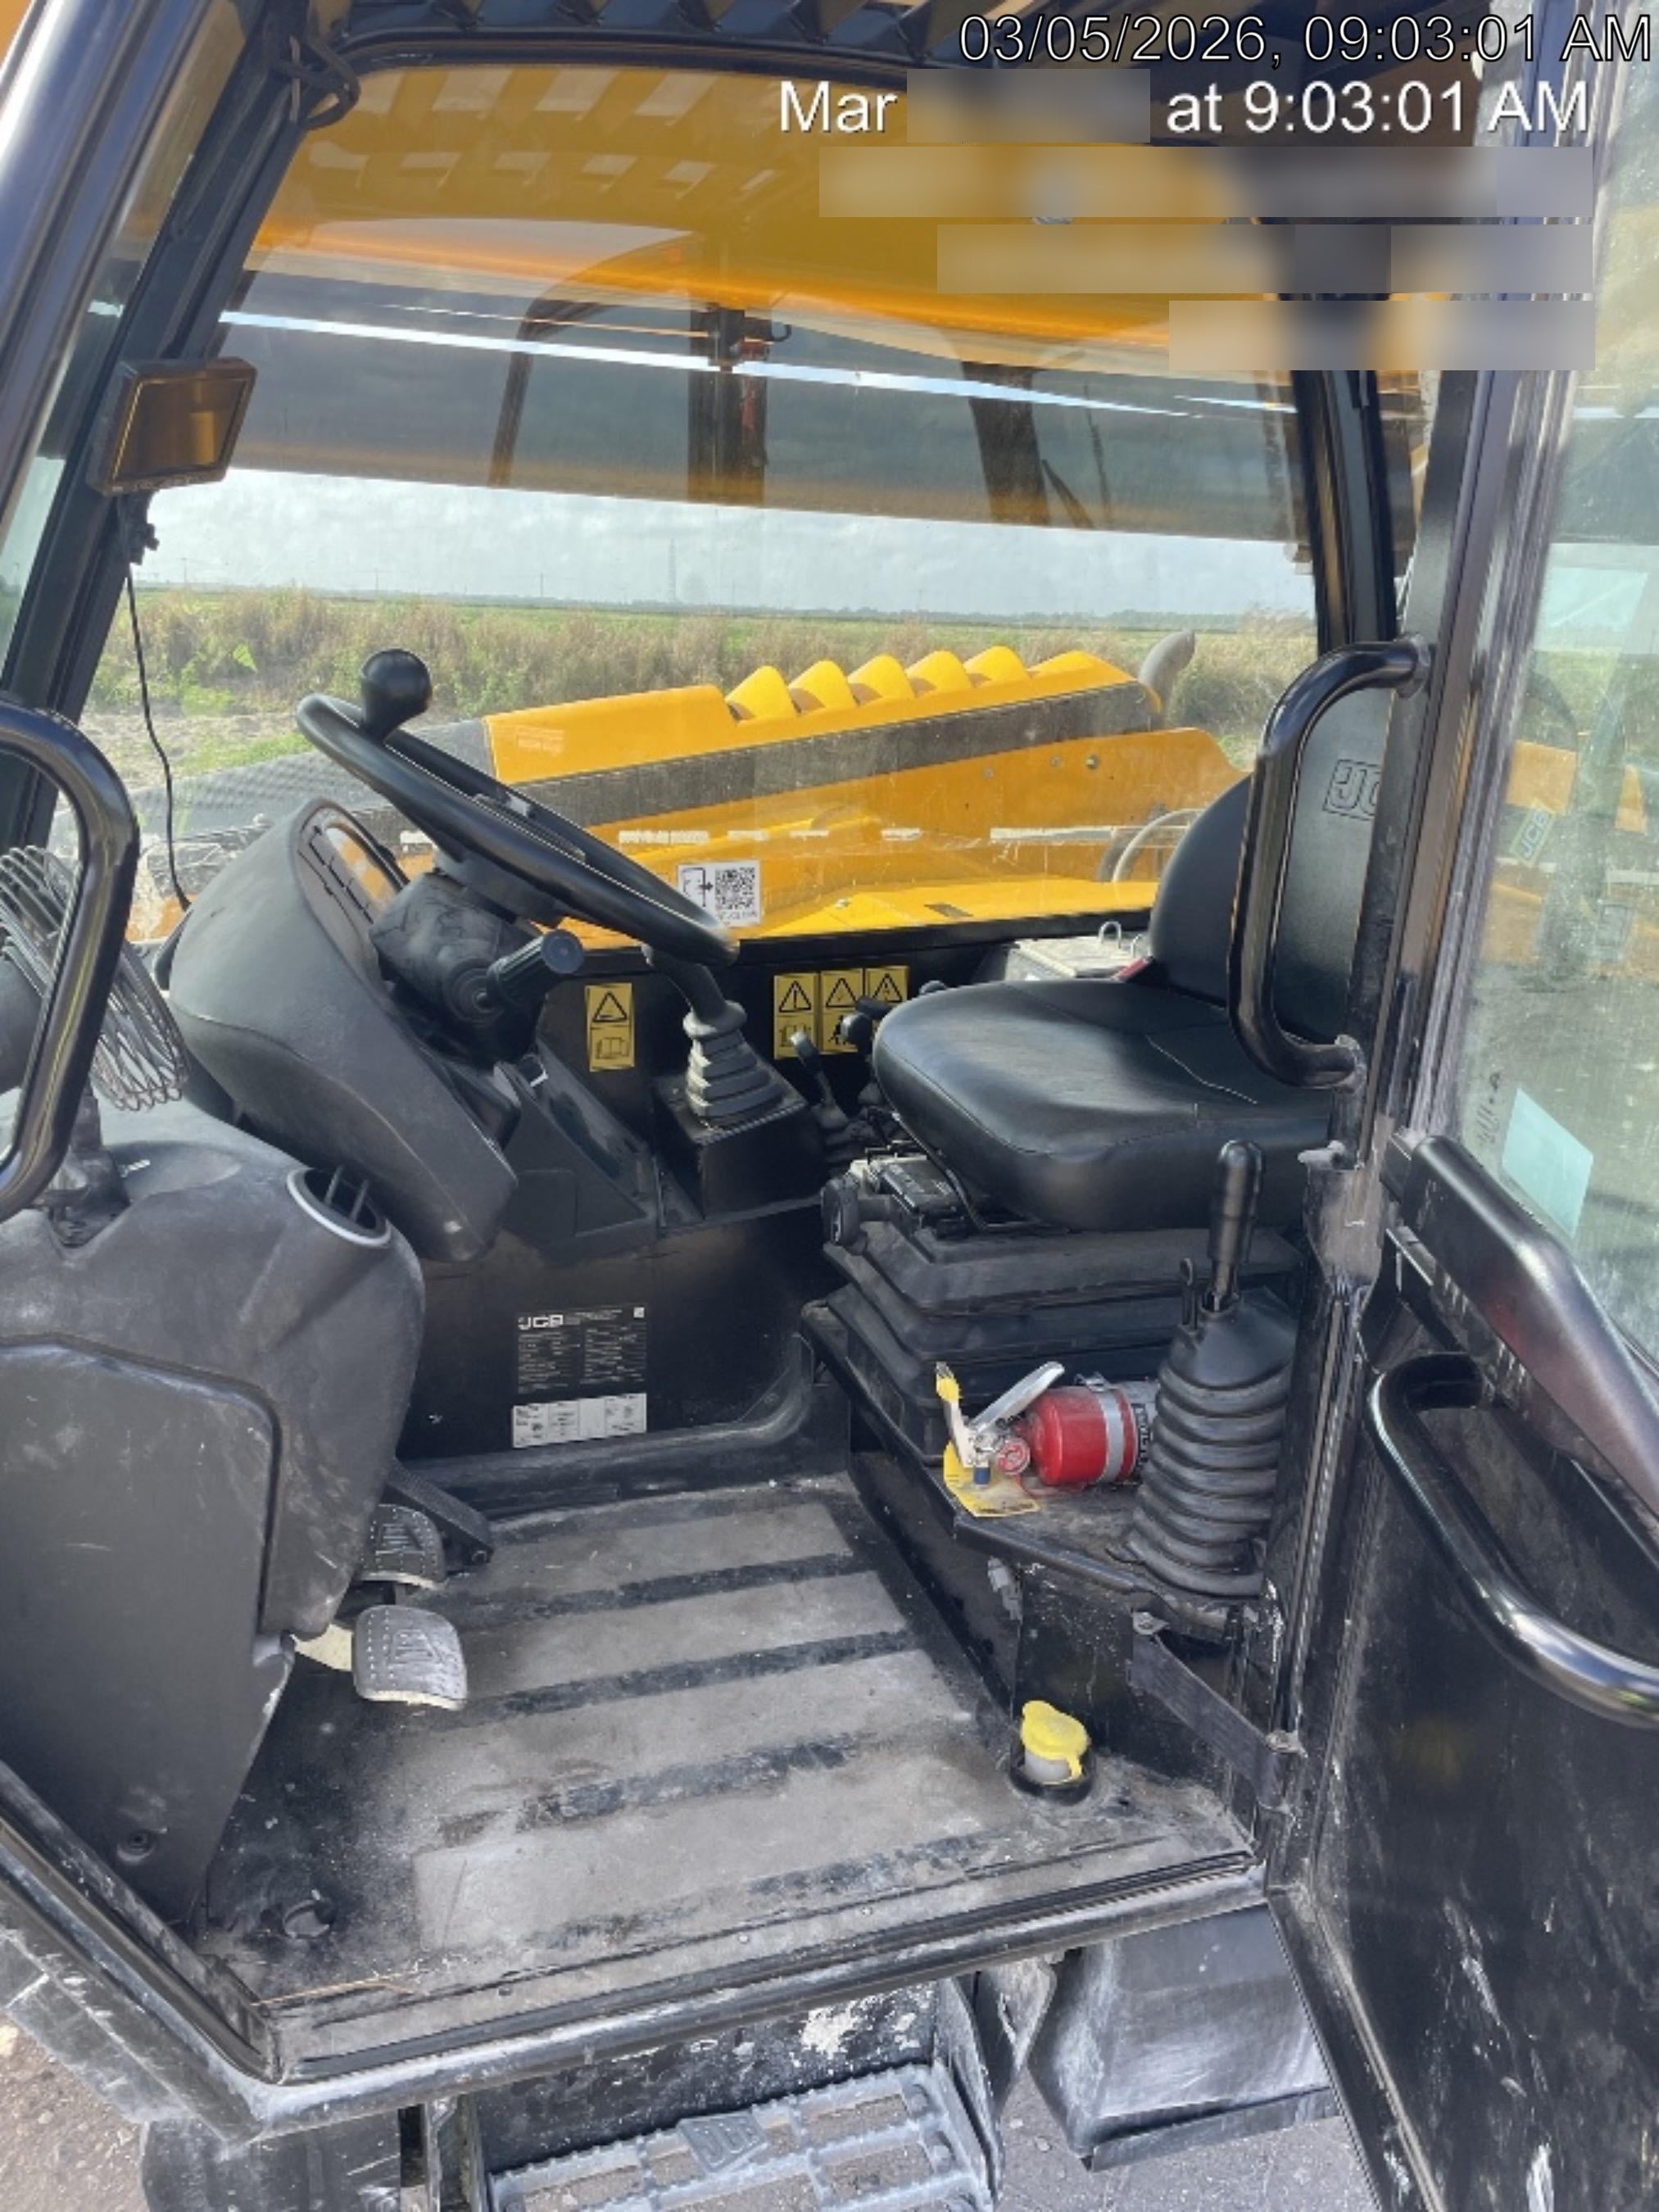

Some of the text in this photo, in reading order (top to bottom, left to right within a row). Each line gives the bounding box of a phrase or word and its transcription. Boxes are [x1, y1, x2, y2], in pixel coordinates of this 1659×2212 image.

[1330, 766, 1380, 817] JC
[1521, 809, 1548, 859] JCB
[518, 1314, 564, 1330] JCB
